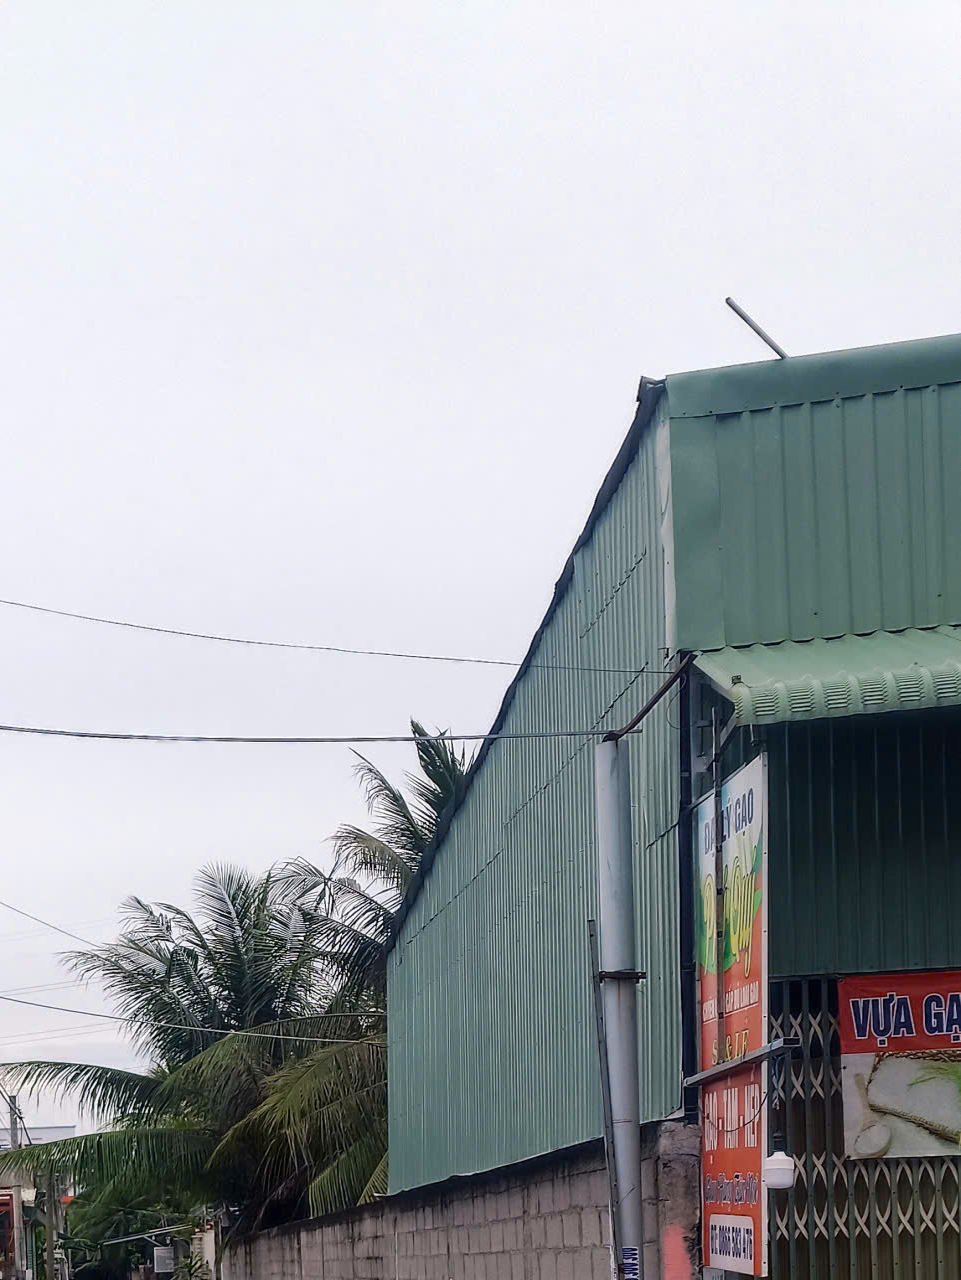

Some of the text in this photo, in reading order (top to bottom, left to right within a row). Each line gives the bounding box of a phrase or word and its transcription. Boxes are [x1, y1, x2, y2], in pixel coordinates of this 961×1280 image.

[734, 786, 755, 838] GẠO
[849, 992, 917, 1047] VỰA
[704, 1090, 718, 1165] GẠO
[723, 1075, 739, 1150] TẤM
[744, 1062, 760, 1149] NẾP
